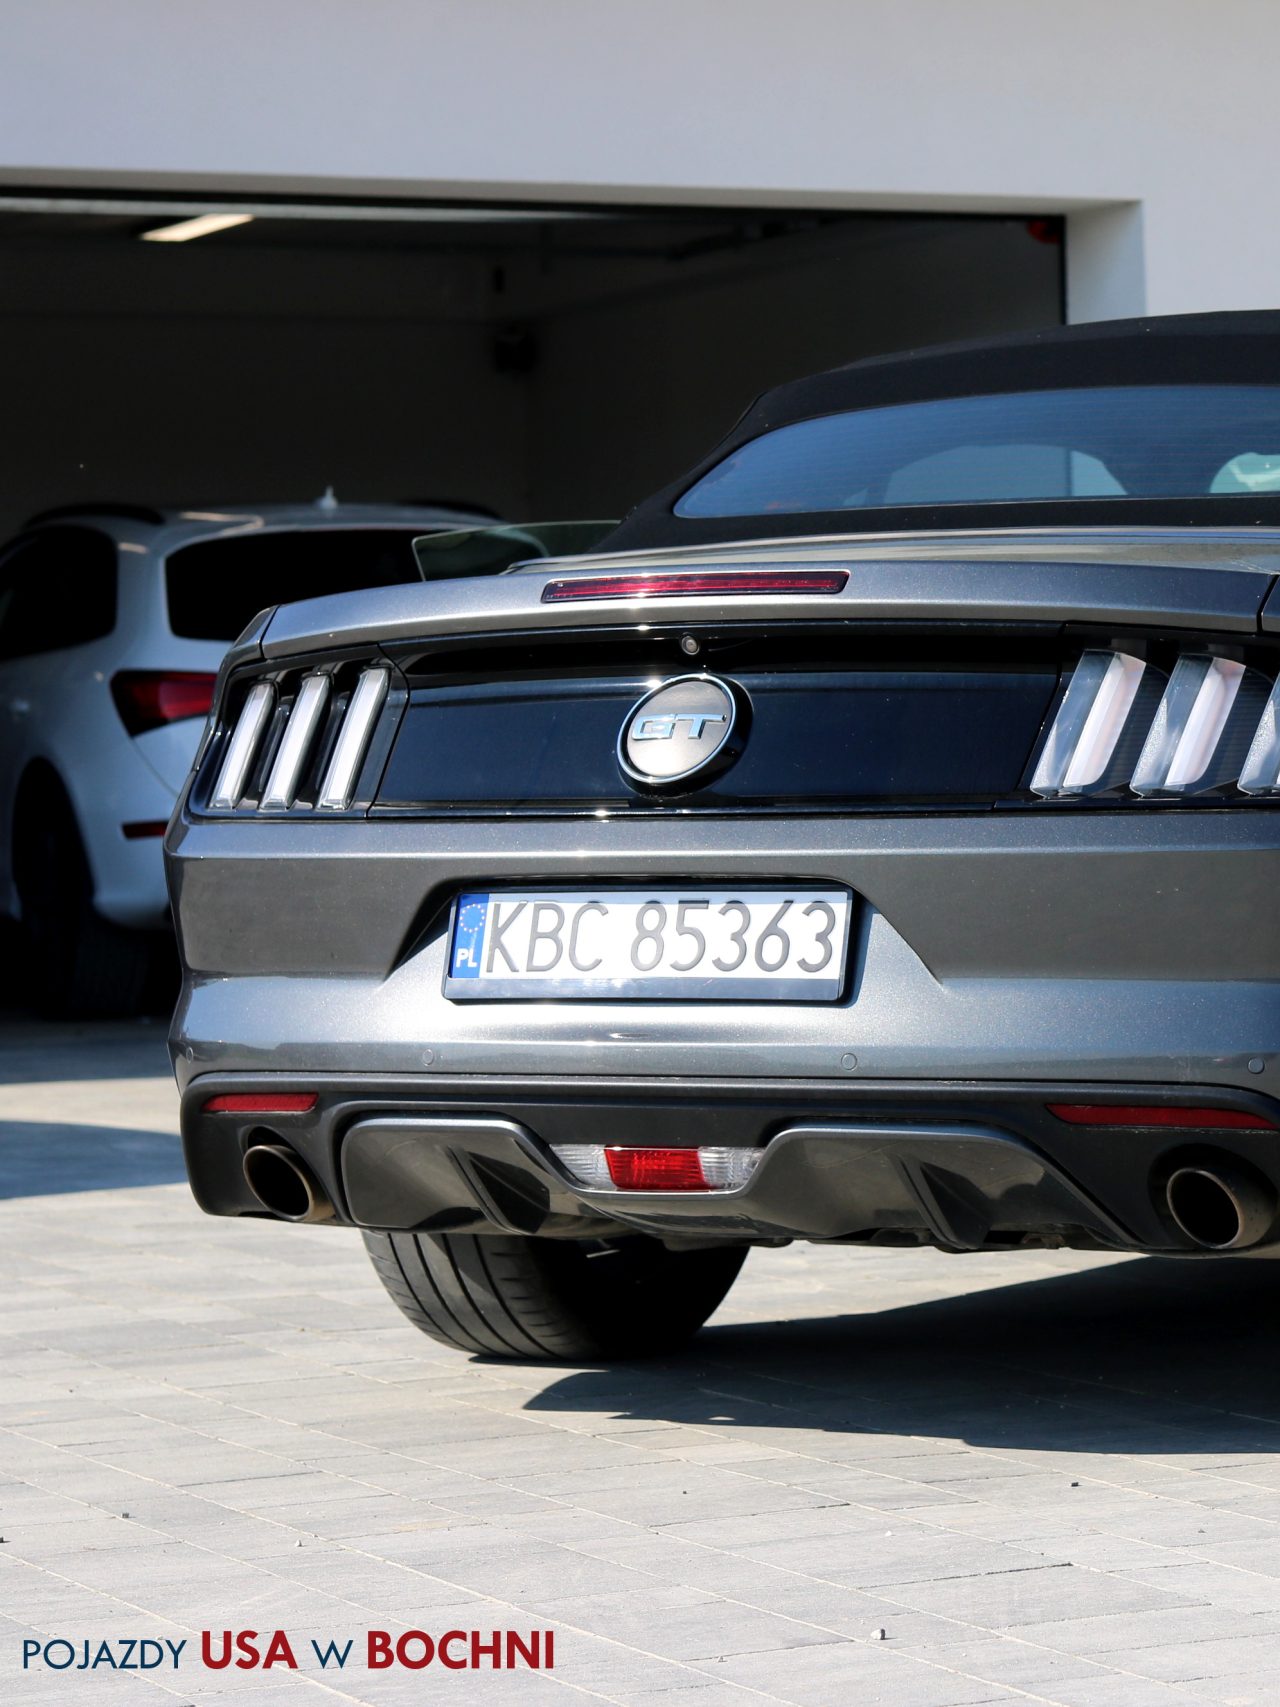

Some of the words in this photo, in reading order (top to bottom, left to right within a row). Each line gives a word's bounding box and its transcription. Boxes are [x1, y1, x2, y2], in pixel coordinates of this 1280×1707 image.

[631, 713, 727, 741] GT
[485, 900, 609, 974] KBC
[630, 900, 836, 973] 85363
[455, 948, 478, 968] PL
